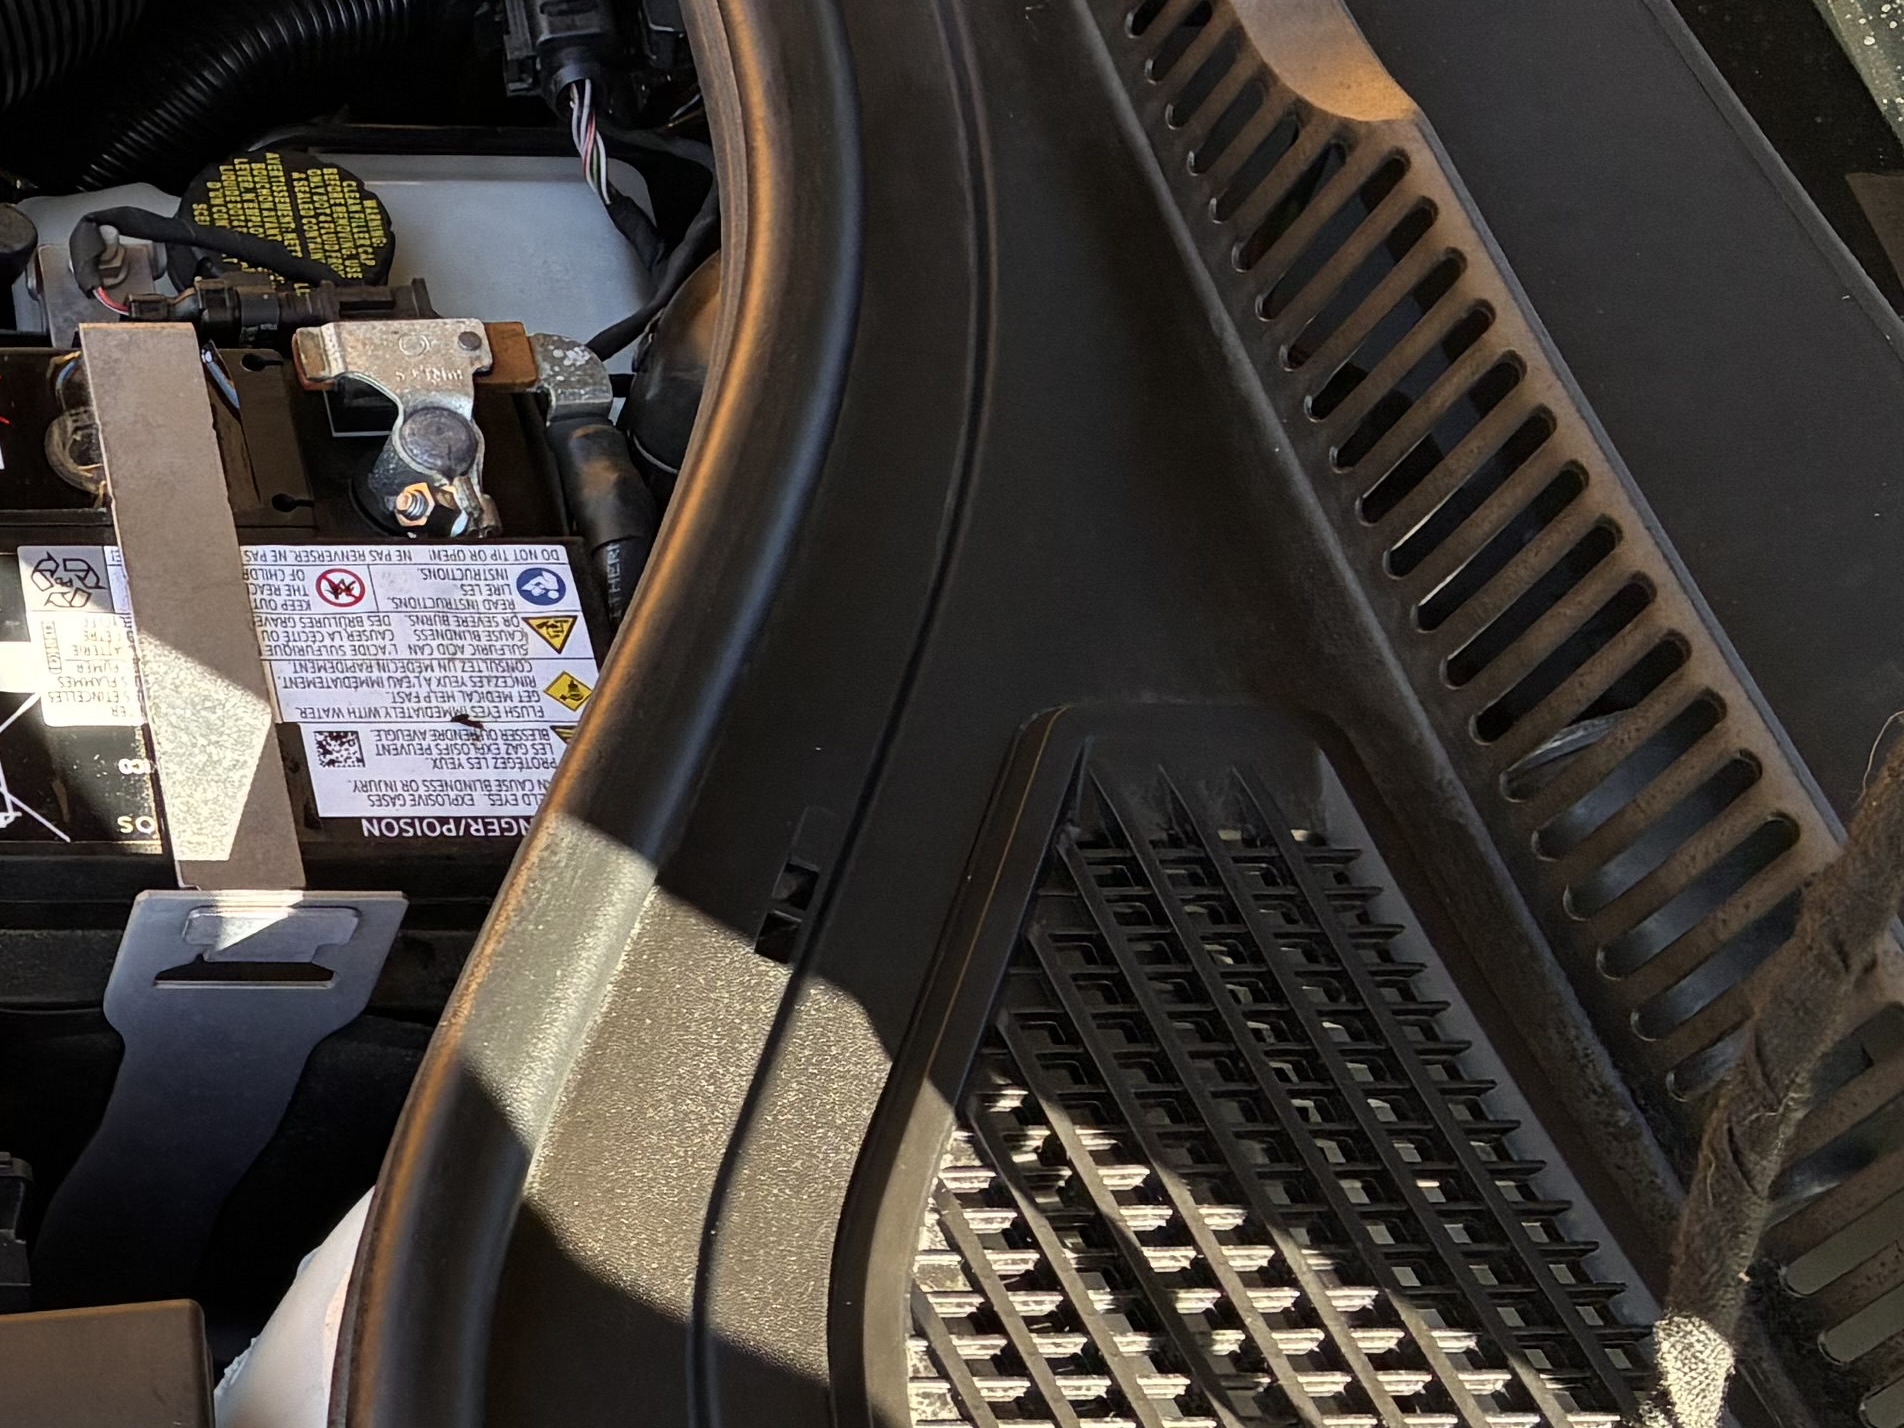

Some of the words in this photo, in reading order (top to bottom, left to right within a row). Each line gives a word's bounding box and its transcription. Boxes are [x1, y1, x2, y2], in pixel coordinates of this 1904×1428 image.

[250, 162, 274, 208] BOUCHON
[292, 180, 315, 216] SEALED
[341, 180, 362, 212] CLEAN
[261, 210, 282, 241] AVANT
[322, 167, 344, 205] BEFORE
[343, 259, 363, 279] USE
[349, 213, 371, 246] FILLER
[301, 217, 326, 263] CONTAIN
[357, 246, 375, 265] CAP
[244, 550, 266, 562] PAS
[269, 550, 286, 562] NE
[369, 550, 391, 561] PAS
[394, 549, 412, 561] NE
[429, 549, 466, 561] OPEN!
[469, 549, 487, 561] OR
[490, 549, 510, 561] TIP
[513, 549, 538, 561] NOT
[542, 549, 559, 561] DO
[243, 569, 285, 581] CHILDR
[288, 569, 305, 580] OF
[418, 568, 508, 580] INSTRUCTIONS.
[249, 584, 282, 596] REAC
[285, 584, 308, 595] THE
[461, 584, 481, 595] LES
[484, 584, 511, 595] LIRE
[253, 599, 277, 610] OUT
[280, 599, 311, 610] KEEP
[387, 598, 479, 610] INSTRUCTIONS.
[482, 598, 515, 610] READ
[254, 616, 296, 627] GRAVE
[299, 615, 364, 630] BRÛLURES
[367, 615, 390, 627] DES
[452, 615, 499, 627] SEVERE
[502, 615, 518, 626] OR
[262, 631, 280, 642] OU
[283, 630, 324, 644] CÉCITÉ
[327, 630, 343, 642] LA
[347, 629, 394, 642] CAUSER
[414, 630, 480, 641] BLINDNESS
[484, 630, 521, 641] CAUSE
[265, 643, 345, 657] SULFURIQUE
[349, 644, 398, 656] L'ACIDE
[408, 644, 434, 655] CAN
[438, 644, 465, 655] ACID
[469, 644, 527, 655] SULFURIC
[377, 661, 433, 675] MÉDECIN
[438, 661, 456, 672] UN
[461, 661, 532, 672] CONSULTEZ
[387, 676, 421, 688] L'EAU
[435, 676, 466, 688] YEUX
[469, 676, 490, 688] LES
[493, 676, 535, 688] RINCEZ
[423, 691, 455, 703] HELP
[459, 691, 513, 703] MEDICAL
[518, 691, 539, 703] GET
[348, 707, 381, 718] WITH
[471, 707, 501, 718] EYES
[505, 707, 544, 718] FLUSH
[499, 729, 549, 741] BLESSER
[375, 744, 431, 755] PEUVENT
[434, 743, 501, 755] EXPLOSIFS
[505, 743, 527, 754] GAZ
[532, 743, 553, 754] LES
[467, 757, 489, 768] LES
[493, 757, 556, 770] PROTÉGEZ
[401, 780, 419, 792] OR
[423, 780, 492, 792] BLINDNESS
[495, 780, 533, 792] CAUSE
[368, 794, 406, 807] GASES
[408, 794, 474, 807] EXPLOSIVE
[522, 794, 544, 806] ELD
[362, 819, 532, 836] NGER/POISON
